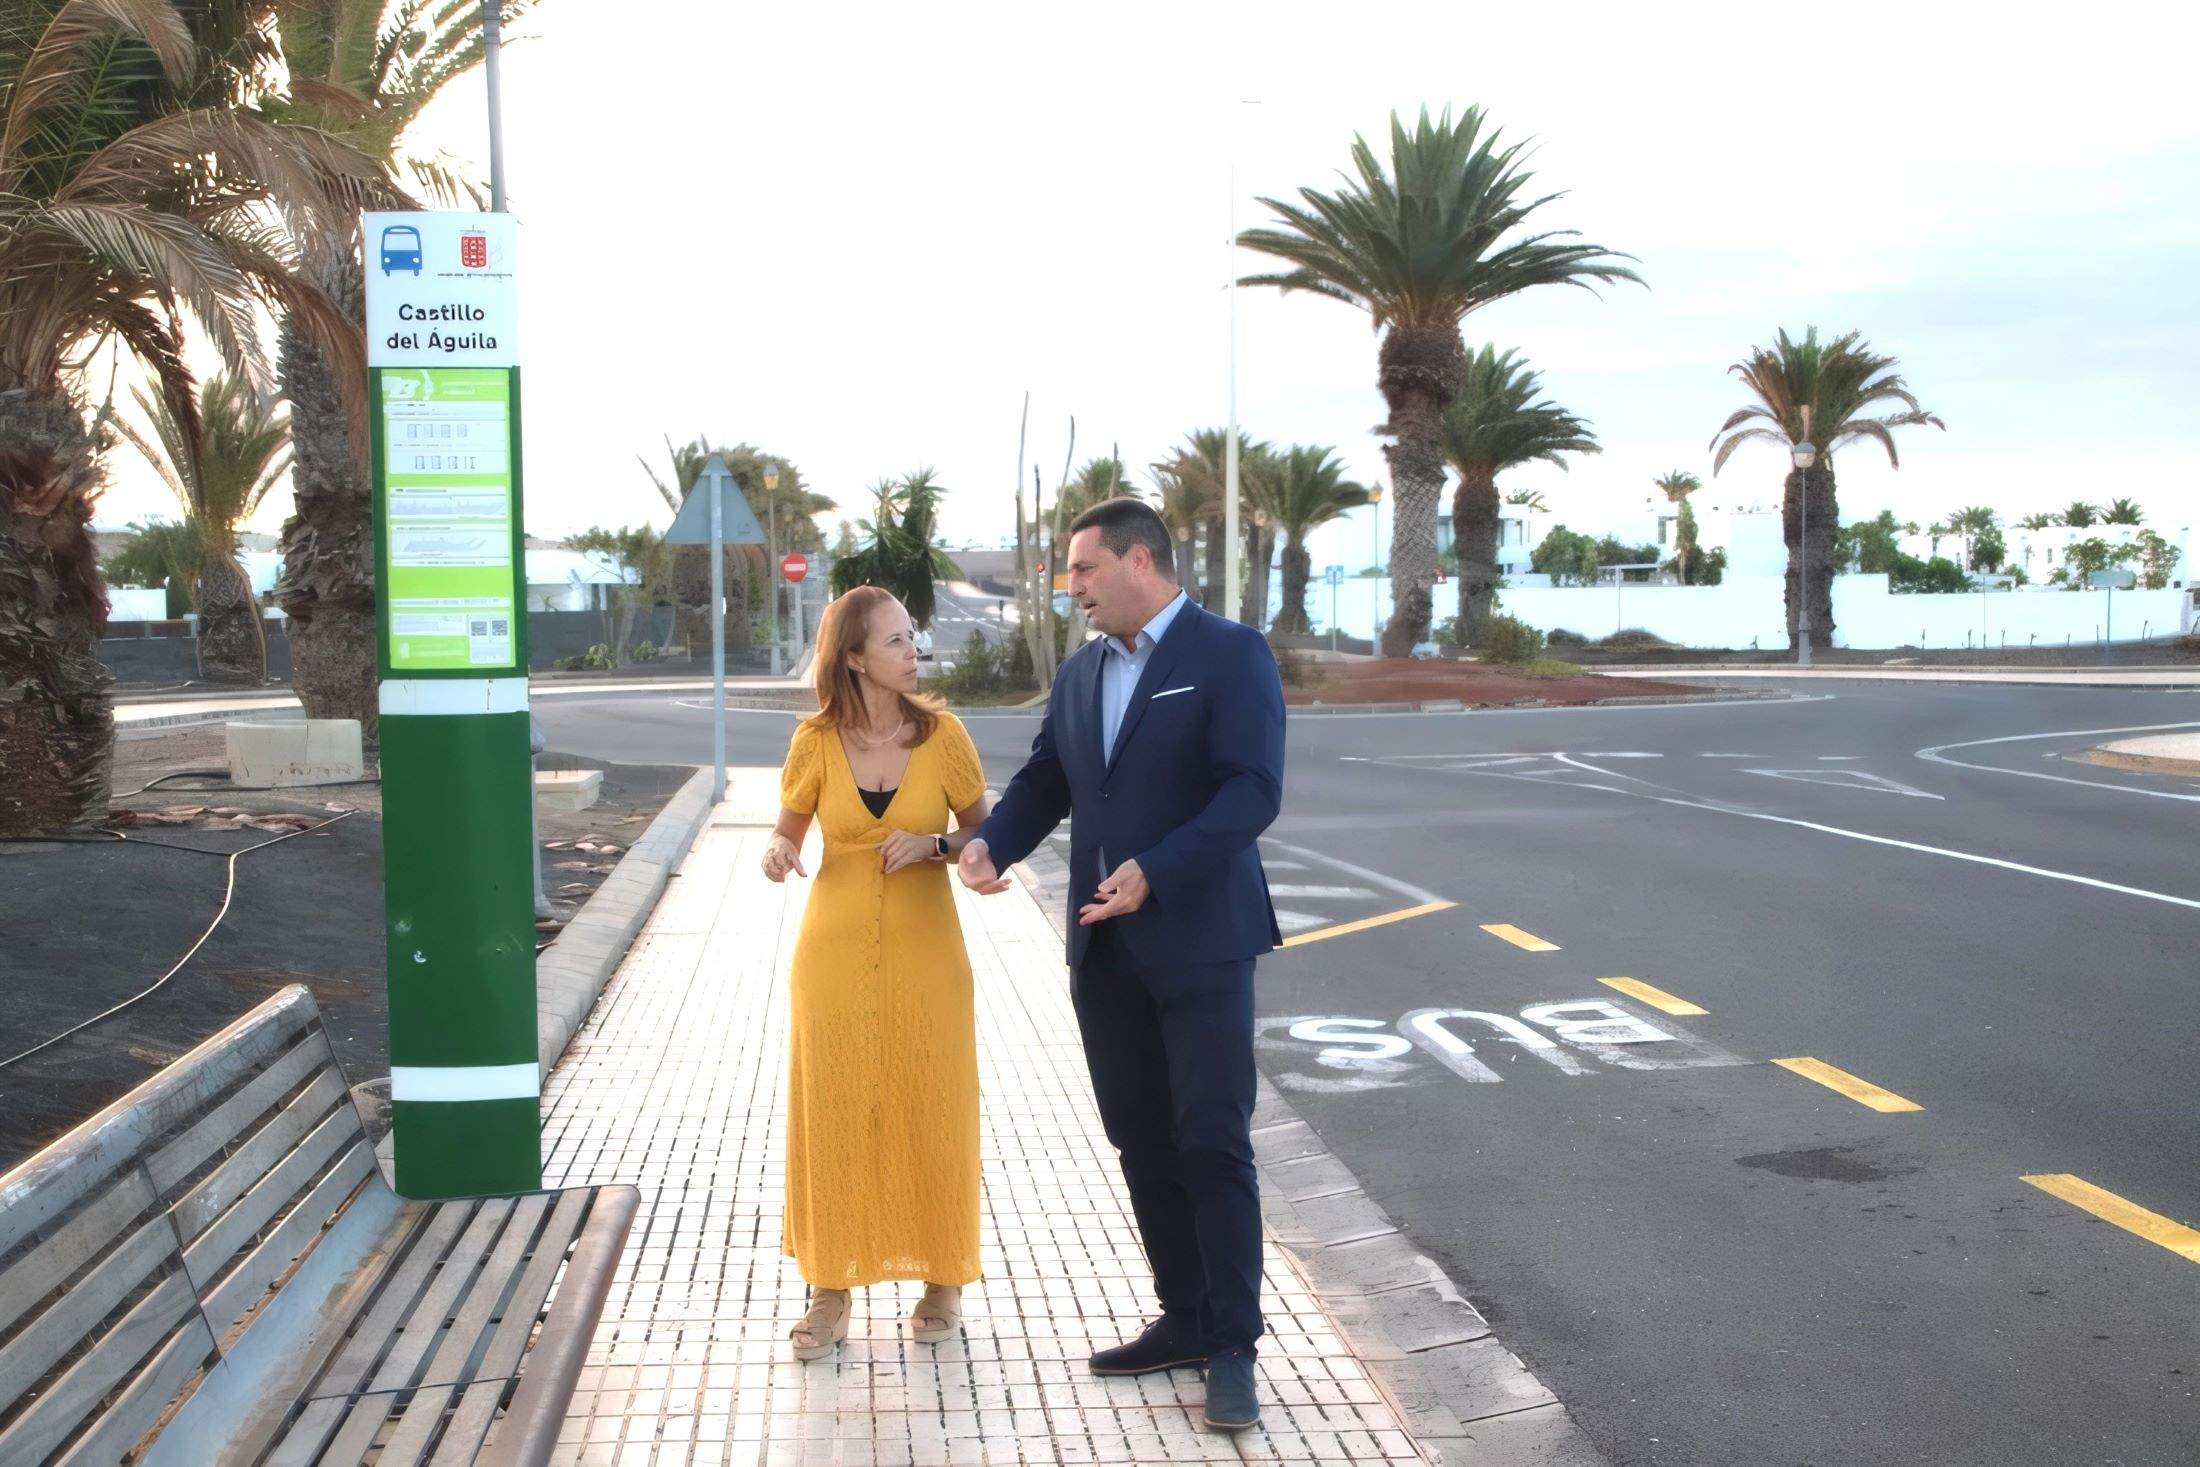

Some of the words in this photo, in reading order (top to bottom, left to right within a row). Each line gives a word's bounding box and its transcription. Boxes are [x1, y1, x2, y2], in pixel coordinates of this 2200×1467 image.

[398, 303, 485, 321] Castillo
[386, 332, 419, 350] del
[427, 327, 498, 352] Águila
[1286, 998, 1684, 1066] BUS
